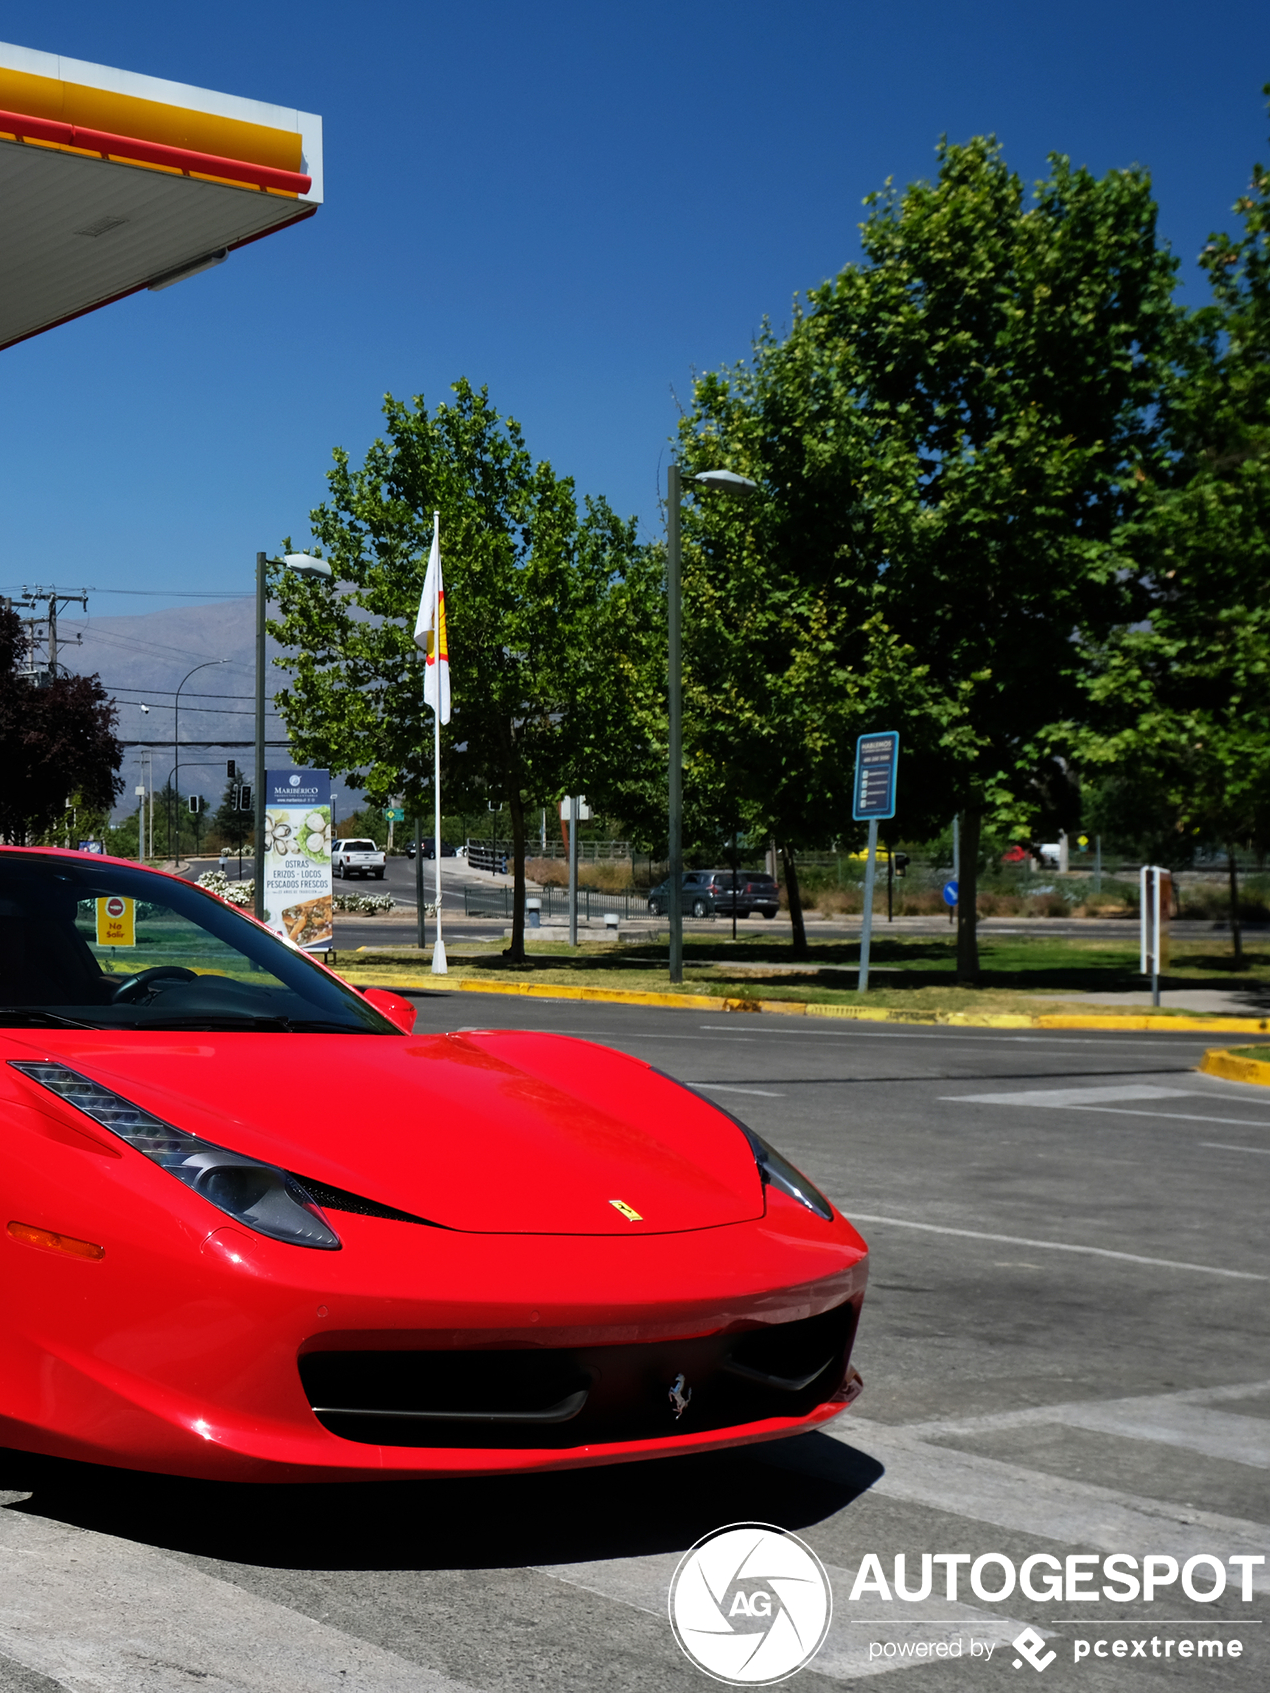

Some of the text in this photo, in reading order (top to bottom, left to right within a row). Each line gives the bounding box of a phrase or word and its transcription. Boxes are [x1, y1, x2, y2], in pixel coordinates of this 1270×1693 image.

[285, 860, 309, 868] OSTRAS
[273, 870, 295, 878] ERIZOS
[301, 870, 322, 878] LOCOS
[266, 880, 328, 888] PESCADOS FRESCOS
[109, 922, 122, 930] No
